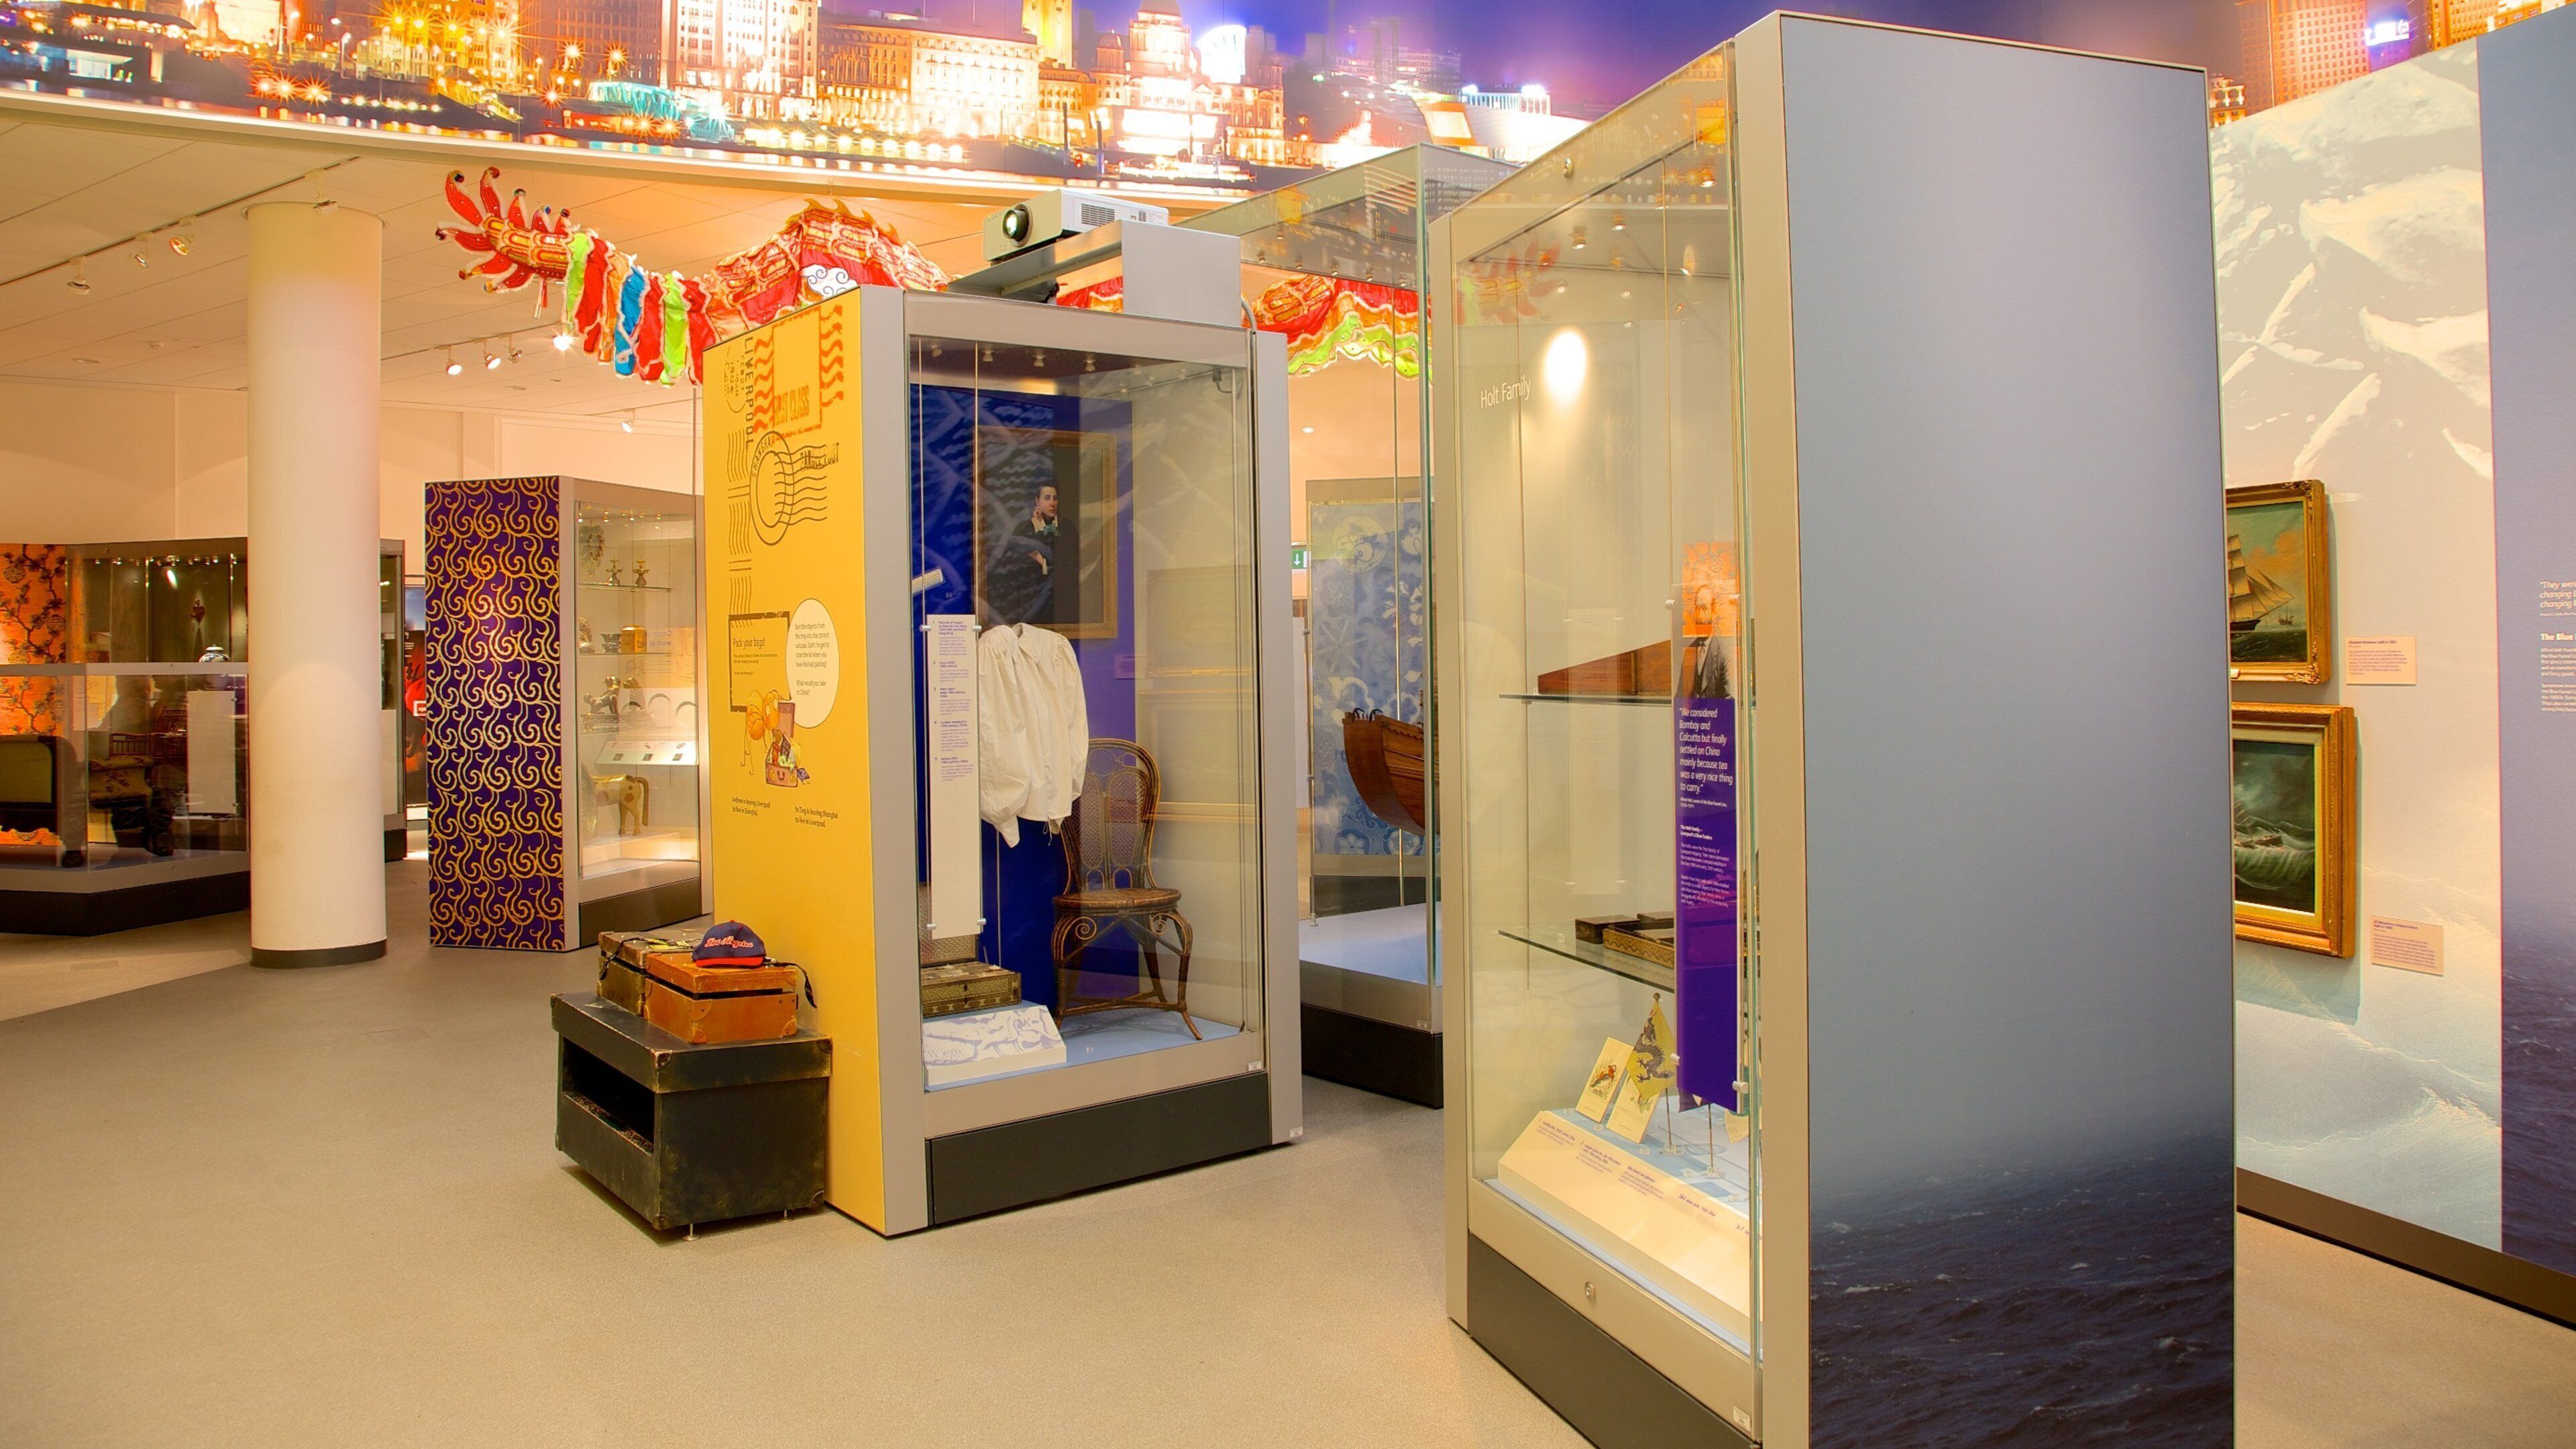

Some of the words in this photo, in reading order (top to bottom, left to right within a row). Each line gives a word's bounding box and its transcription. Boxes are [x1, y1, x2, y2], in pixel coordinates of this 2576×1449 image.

[745, 336, 754, 450] LIVERPOOL
[1481, 385, 1499, 409] Holt
[1502, 374, 1531, 401] Family
[790, 385, 809, 421] CLASS
[2540, 591, 2572, 599] changing
[2540, 600, 2572, 609] changing
[733, 637, 742, 648] Pack
[743, 639, 753, 650] your
[753, 637, 765, 649] bags!
[1690, 708, 1717, 718] considered
[1679, 720, 1700, 732] Bombay
[1700, 720, 1711, 730] and
[1679, 732, 1701, 742] Calcutta
[1701, 733, 1711, 743] but
[1711, 734, 1727, 746] finally
[1680, 745, 1697, 755] settled
[1705, 746, 1721, 756] China
[1680, 757, 1696, 769] mainly
[1697, 758, 1718, 769] because
[1719, 761, 1728, 769] tea
[1680, 771, 1690, 779] was
[1695, 773, 1707, 783] very
[1707, 771, 1718, 782] nice
[1719, 773, 1733, 786] thing
[1680, 782, 1686, 791] to
[704, 938, 720, 948] Los
[720, 936, 754, 949] Angeles
